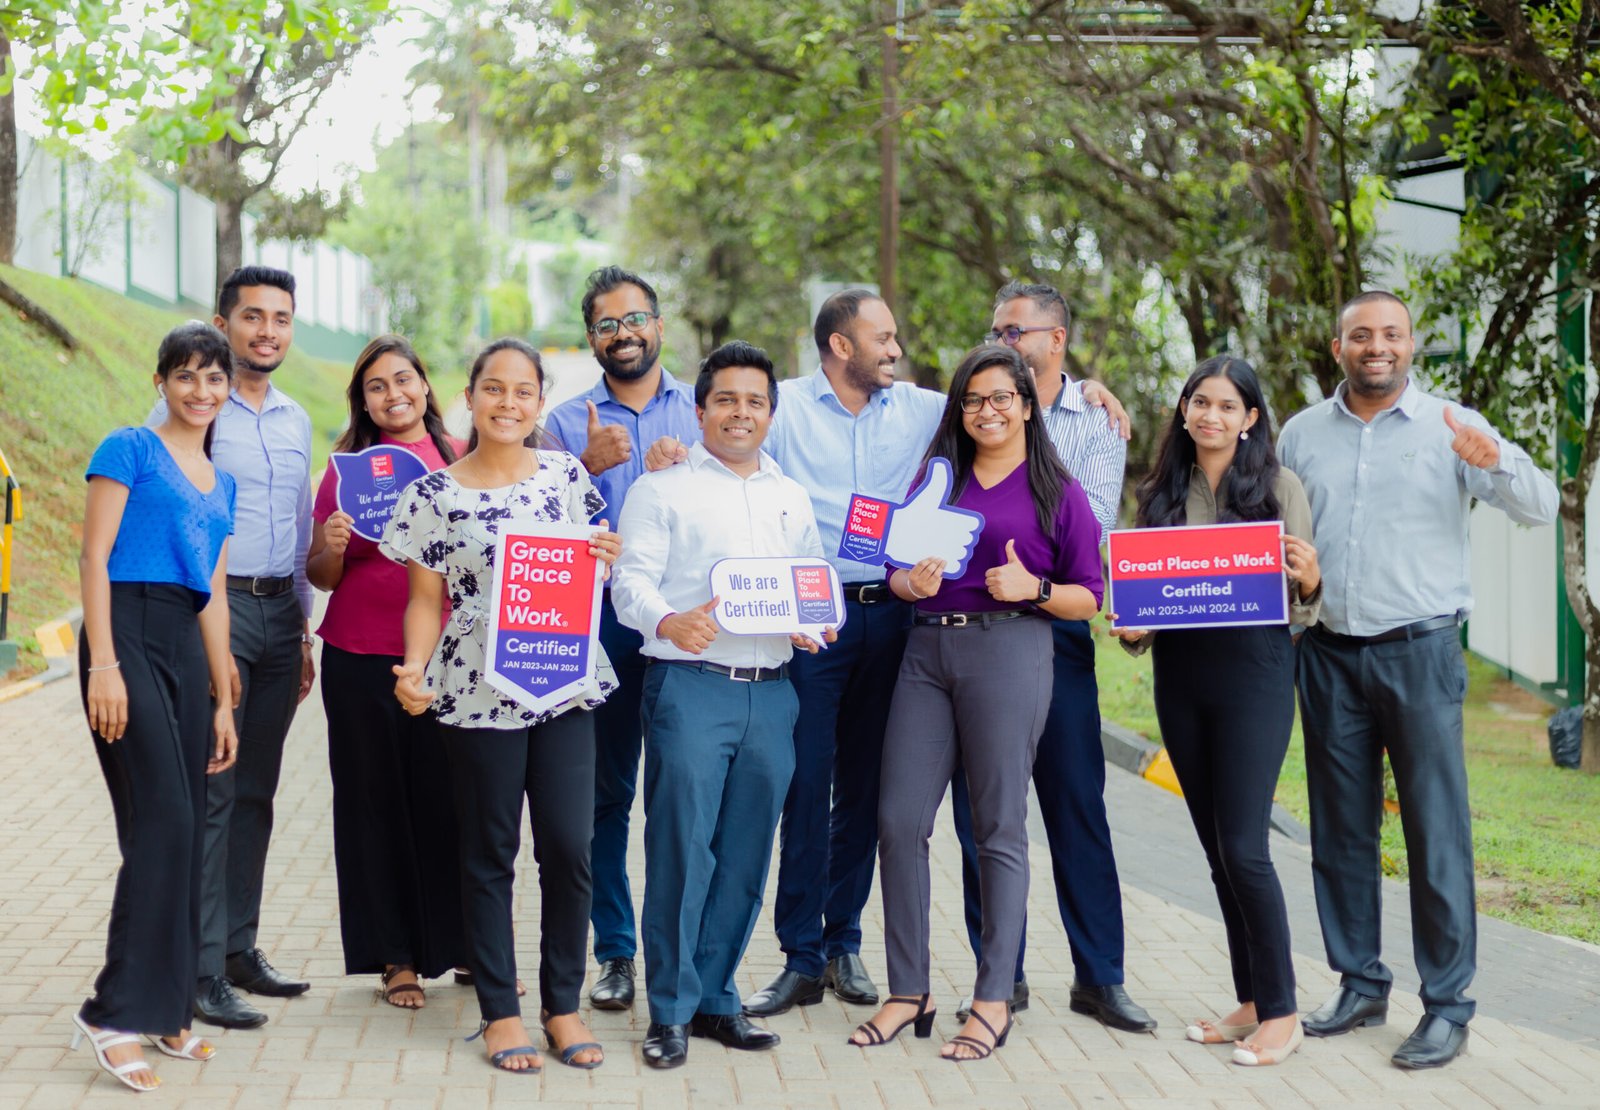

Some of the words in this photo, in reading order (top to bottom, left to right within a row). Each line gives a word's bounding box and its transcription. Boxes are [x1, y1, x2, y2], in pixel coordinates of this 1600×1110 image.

[373, 491, 382, 502] all
[366, 507, 388, 519] Great
[854, 507, 878, 519] Place
[855, 499, 880, 512] Great
[852, 514, 862, 523] To
[848, 534, 877, 546] Certified
[510, 541, 575, 564] Great
[1118, 559, 1163, 573] Great
[1166, 555, 1210, 571] Place
[1213, 556, 1229, 568] to
[1232, 551, 1275, 568] Work
[509, 562, 572, 584] Place
[729, 574, 752, 590] We
[755, 576, 778, 590] are
[1162, 580, 1232, 598] Certified
[507, 584, 532, 603] To
[724, 599, 791, 618] Certified!
[1137, 606, 1155, 617] JAN
[1158, 604, 1206, 616] 2023-JAN
[1208, 602, 1236, 614] 2024
[1241, 602, 1260, 612] LKA
[505, 637, 580, 657] Certified
[503, 661, 520, 669] JAN
[521, 661, 559, 671] 2023-JAN
[560, 663, 579, 672] 2024
[531, 676, 548, 685] LKA
